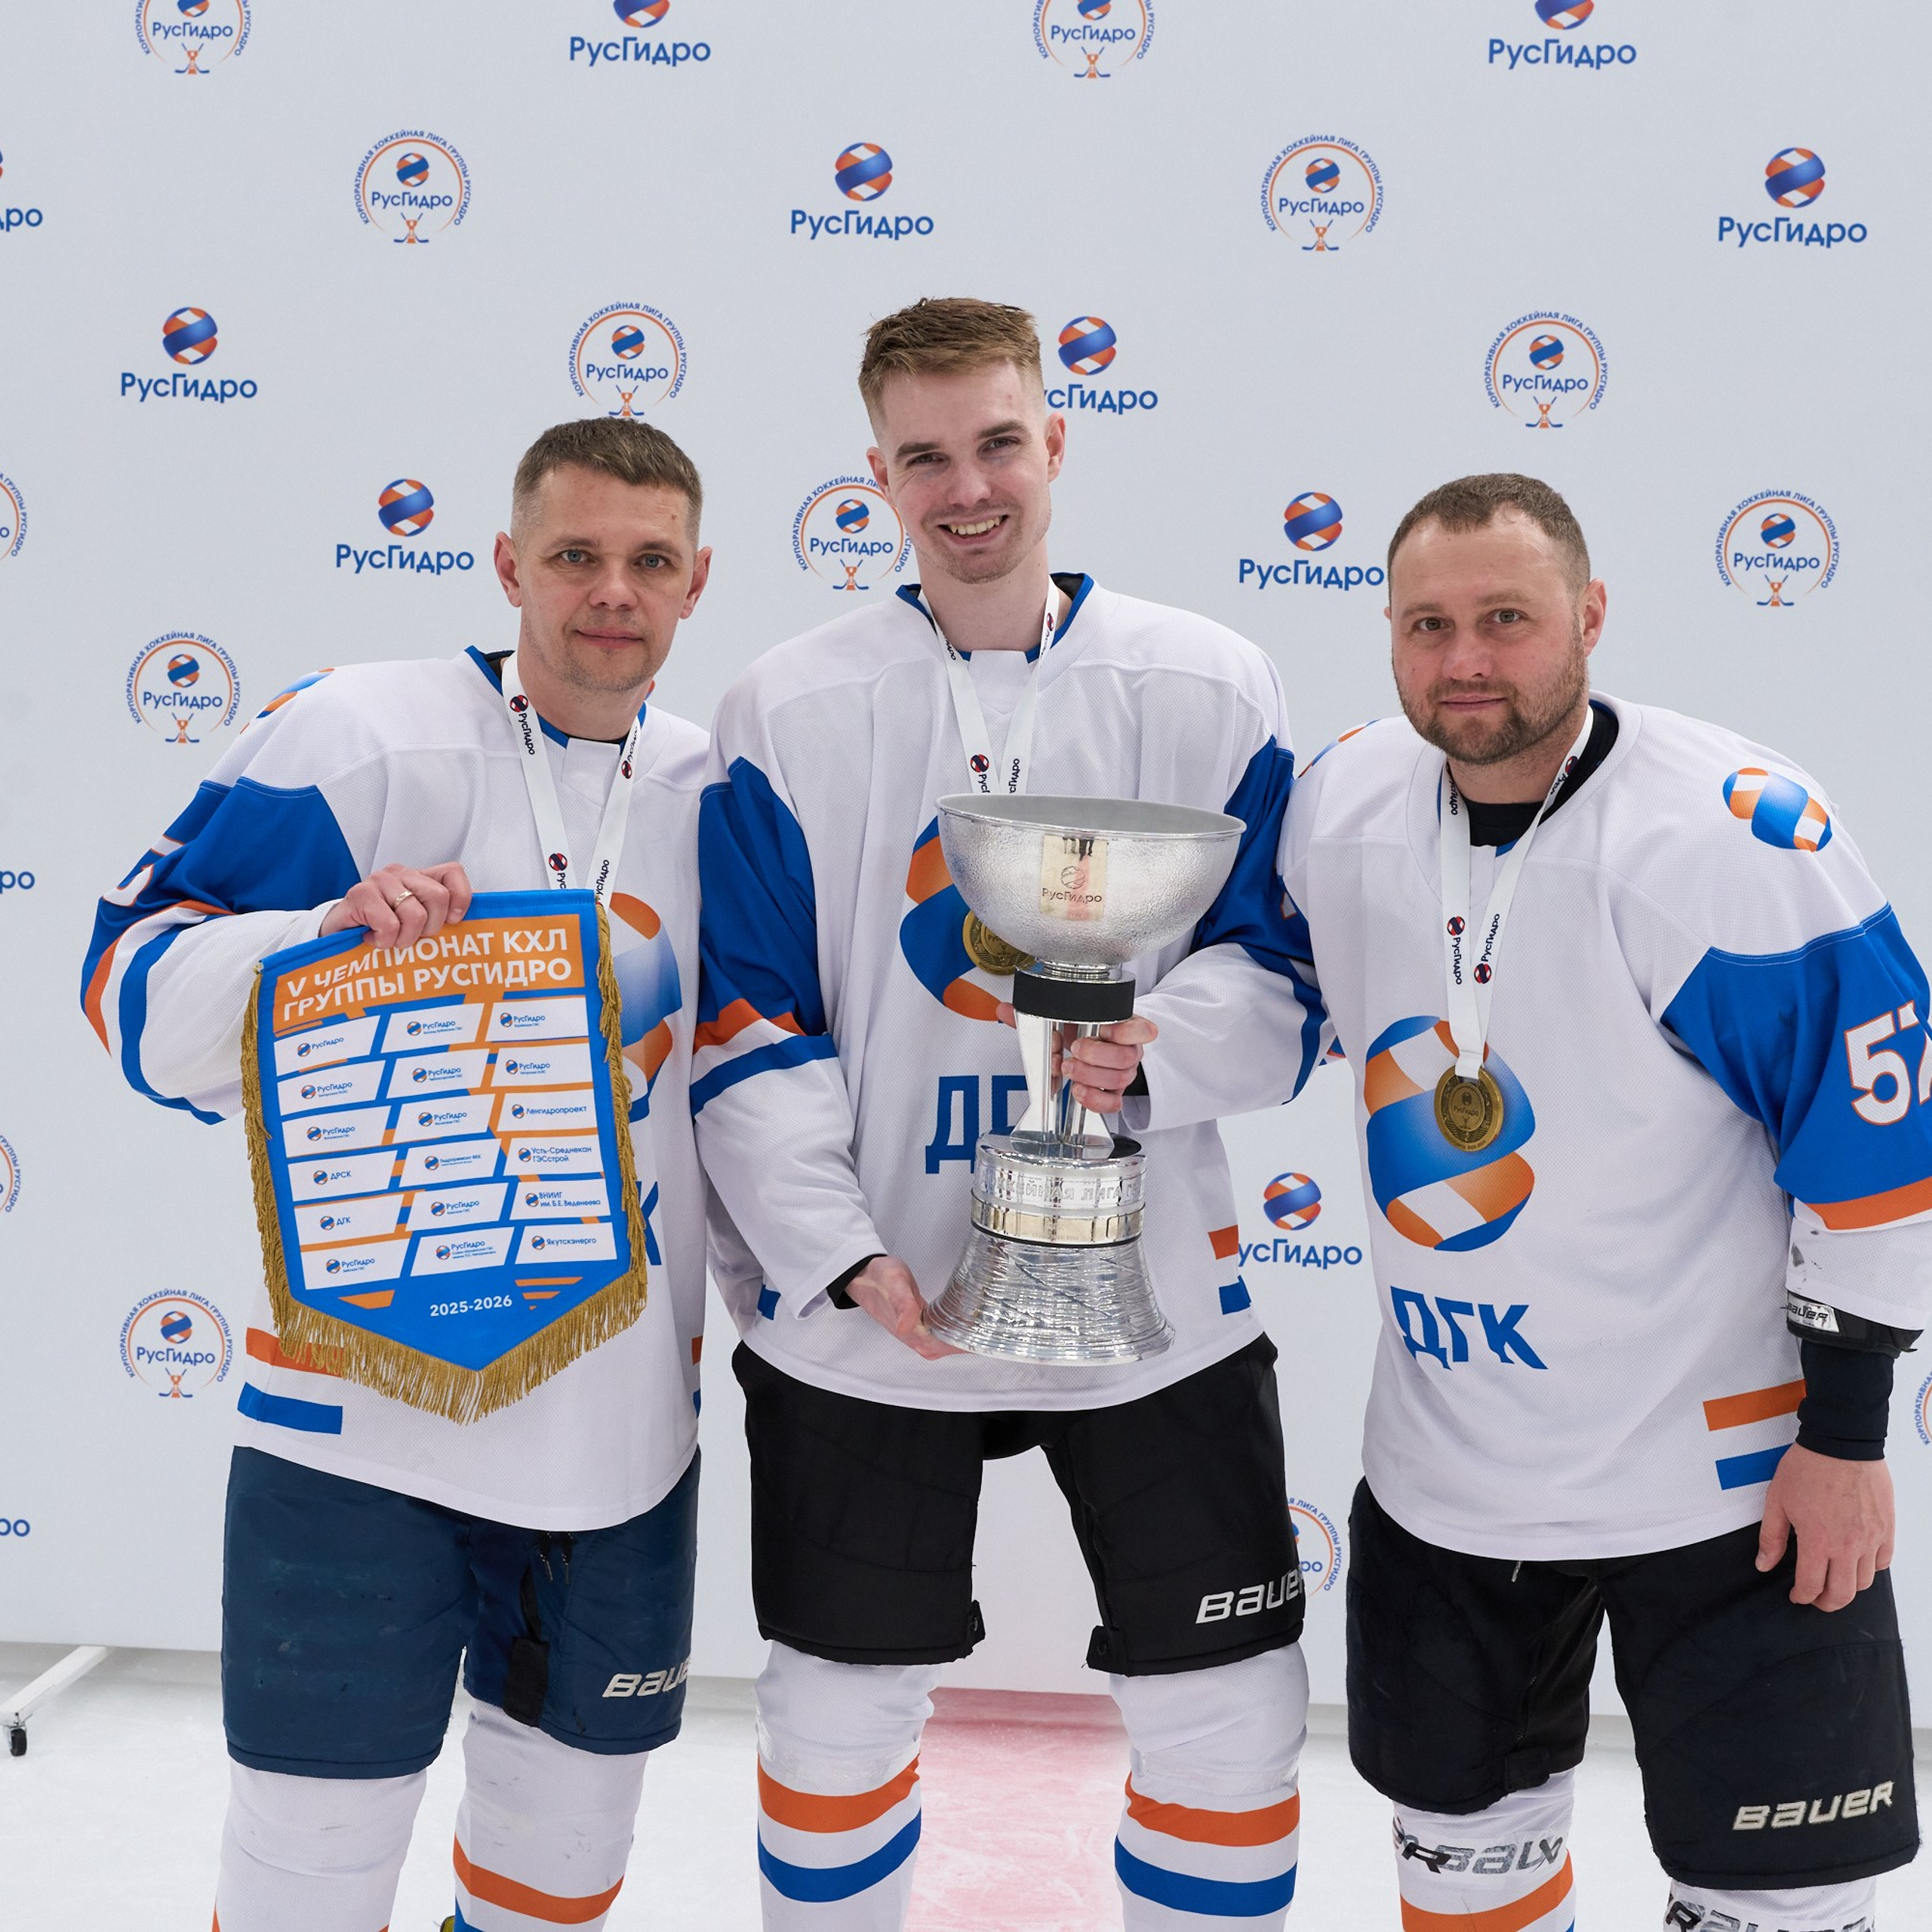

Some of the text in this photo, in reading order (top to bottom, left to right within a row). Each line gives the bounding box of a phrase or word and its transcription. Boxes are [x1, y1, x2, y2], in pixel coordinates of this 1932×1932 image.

[135, 0, 151, 54] КОРПОРАТИ
[152, 22, 233, 41] РусГидро
[234, 11, 251, 56] РУСГИДРО
[1051, 25, 1136, 44] РусГидро
[1137, 13, 1155, 60] РУСГИДРО
[570, 36, 711, 67] РусГидро
[1489, 38, 1636, 70] РусГидро
[354, 130, 471, 226] КОРПОРАТИВНАЯ ХОККЕЙНАЯ ЛИГА ГРУППЫ РУСГИДРО
[1260, 134, 1383, 232] КОРПОРАТИВНАЯ ХОККЕЙНАЯ ЛИГА ГРУППЫ РУСГИДРО
[371, 191, 453, 210] РусГидро
[1279, 198, 1364, 217] РусГидро
[791, 210, 934, 241] РусГидро
[1718, 217, 1867, 248] РусГидро
[568, 302, 687, 398] КОРПОРАТИВНАЯ ХОККЕЙНАЯ ЛИГА ГРУППЫ РУСГИДРО
[1484, 311, 1608, 410] КОРПОРАТИВНАЯ ХОККЕЙНАЯ ЛИГА ГРУППЫ РУСГИДРО
[121, 372, 257, 403] РусГидро
[586, 364, 669, 383] РусГидро
[1503, 374, 1589, 393] РусГидро
[1044, 384, 1158, 415] сГидро
[4, 478, 26, 510] ГРУППЫ
[11, 512, 27, 557] РУСГИДРО
[792, 496, 813, 571] КОРПОРАТИВНАЯ
[811, 475, 865, 497] ХОККЕЙНАЯ
[894, 534, 912, 573] СГИДРО
[1715, 489, 1840, 588] КОРПОРАТИВНАЯ ХОККЕЙНАЯ ЛИГА ГРУППЫ РУСГИДРО
[337, 544, 474, 575] РусГидро
[810, 538, 894, 557] РусГидро
[1734, 553, 1820, 572] РусГидро
[1239, 558, 1384, 591] РусГидро
[126, 631, 240, 726] КОРПОРАТИВНАЯ ХОККЕЙНАЯ ЛИГА ГРУППЫ РУСГИДРО
[143, 692, 223, 710] РусГидро
[518, 712, 535, 755] РусГидро
[1008, 758, 1020, 793] сГидро
[595, 859, 610, 897] усГидро
[1041, 888, 1103, 904] РусГидро
[1481, 913, 1500, 963] РусГидро
[287, 928, 568, 998] V ЧЕМПИОНАТ КХЛ
[1453, 937, 1463, 985] РусГидро
[284, 957, 572, 1021] ГРУППЫ РУСГИДРО
[423, 1021, 456, 1029] РусГидро
[312, 1037, 344, 1050] РусГидро
[428, 1067, 461, 1076] РусГидро
[317, 1082, 352, 1093] РусГидро
[434, 1112, 467, 1121] РусГидро
[526, 1106, 587, 1115] Ленгидропроект
[925, 1075, 1072, 1174] ДГ
[322, 1127, 355, 1135] РусГидро
[531, 1146, 592, 1155] Усть-Среднекан
[5, 1169, 20, 1212] РУСГИДРО
[331, 1171, 352, 1180] ДРСК
[446, 1201, 480, 1210] РусГидро
[336, 1217, 351, 1226] ДГК
[451, 1241, 485, 1251] РусГидро
[546, 1238, 596, 1246] Якутскэнерго
[1238, 1238, 1362, 1269] усГидро
[341, 1258, 375, 1268] РусГидро
[429, 1295, 512, 1317] 2025-2026
[119, 1289, 232, 1382] КОРПОРАТИВНАЯ ХОККЕЙНАЯ ЛИГА ГРУППЫ РУСГИДРО
[1390, 1285, 1549, 1371] ДГК
[137, 1349, 215, 1366] РусГидро
[1297, 1500, 1342, 1591] ЛИГА ГРУППЫ РУСГИДРО
